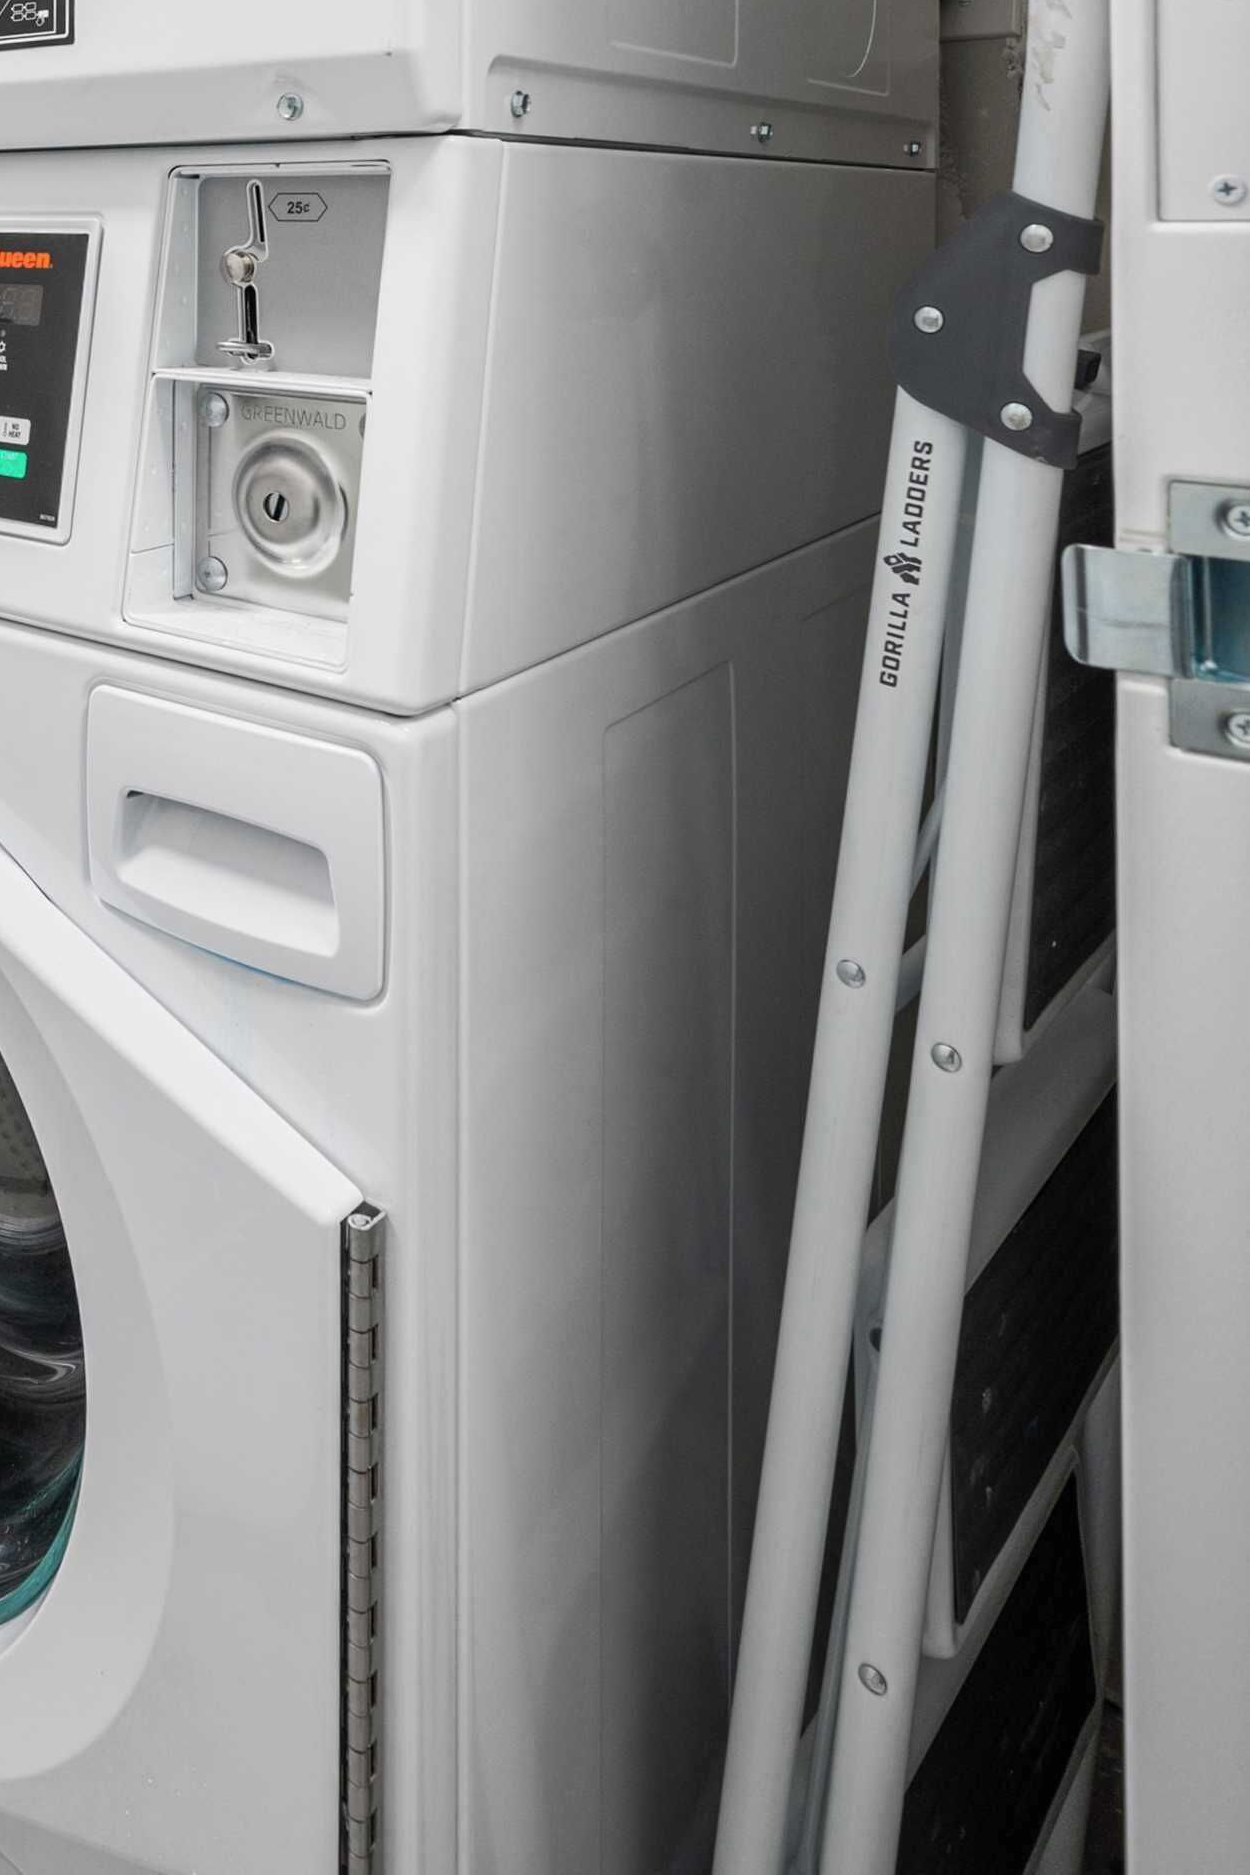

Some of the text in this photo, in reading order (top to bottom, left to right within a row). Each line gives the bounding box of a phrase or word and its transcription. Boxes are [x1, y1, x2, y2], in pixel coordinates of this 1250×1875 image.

[240, 404, 347, 430] GREENWALD
[879, 440, 933, 687] GORILLA LADDERS
